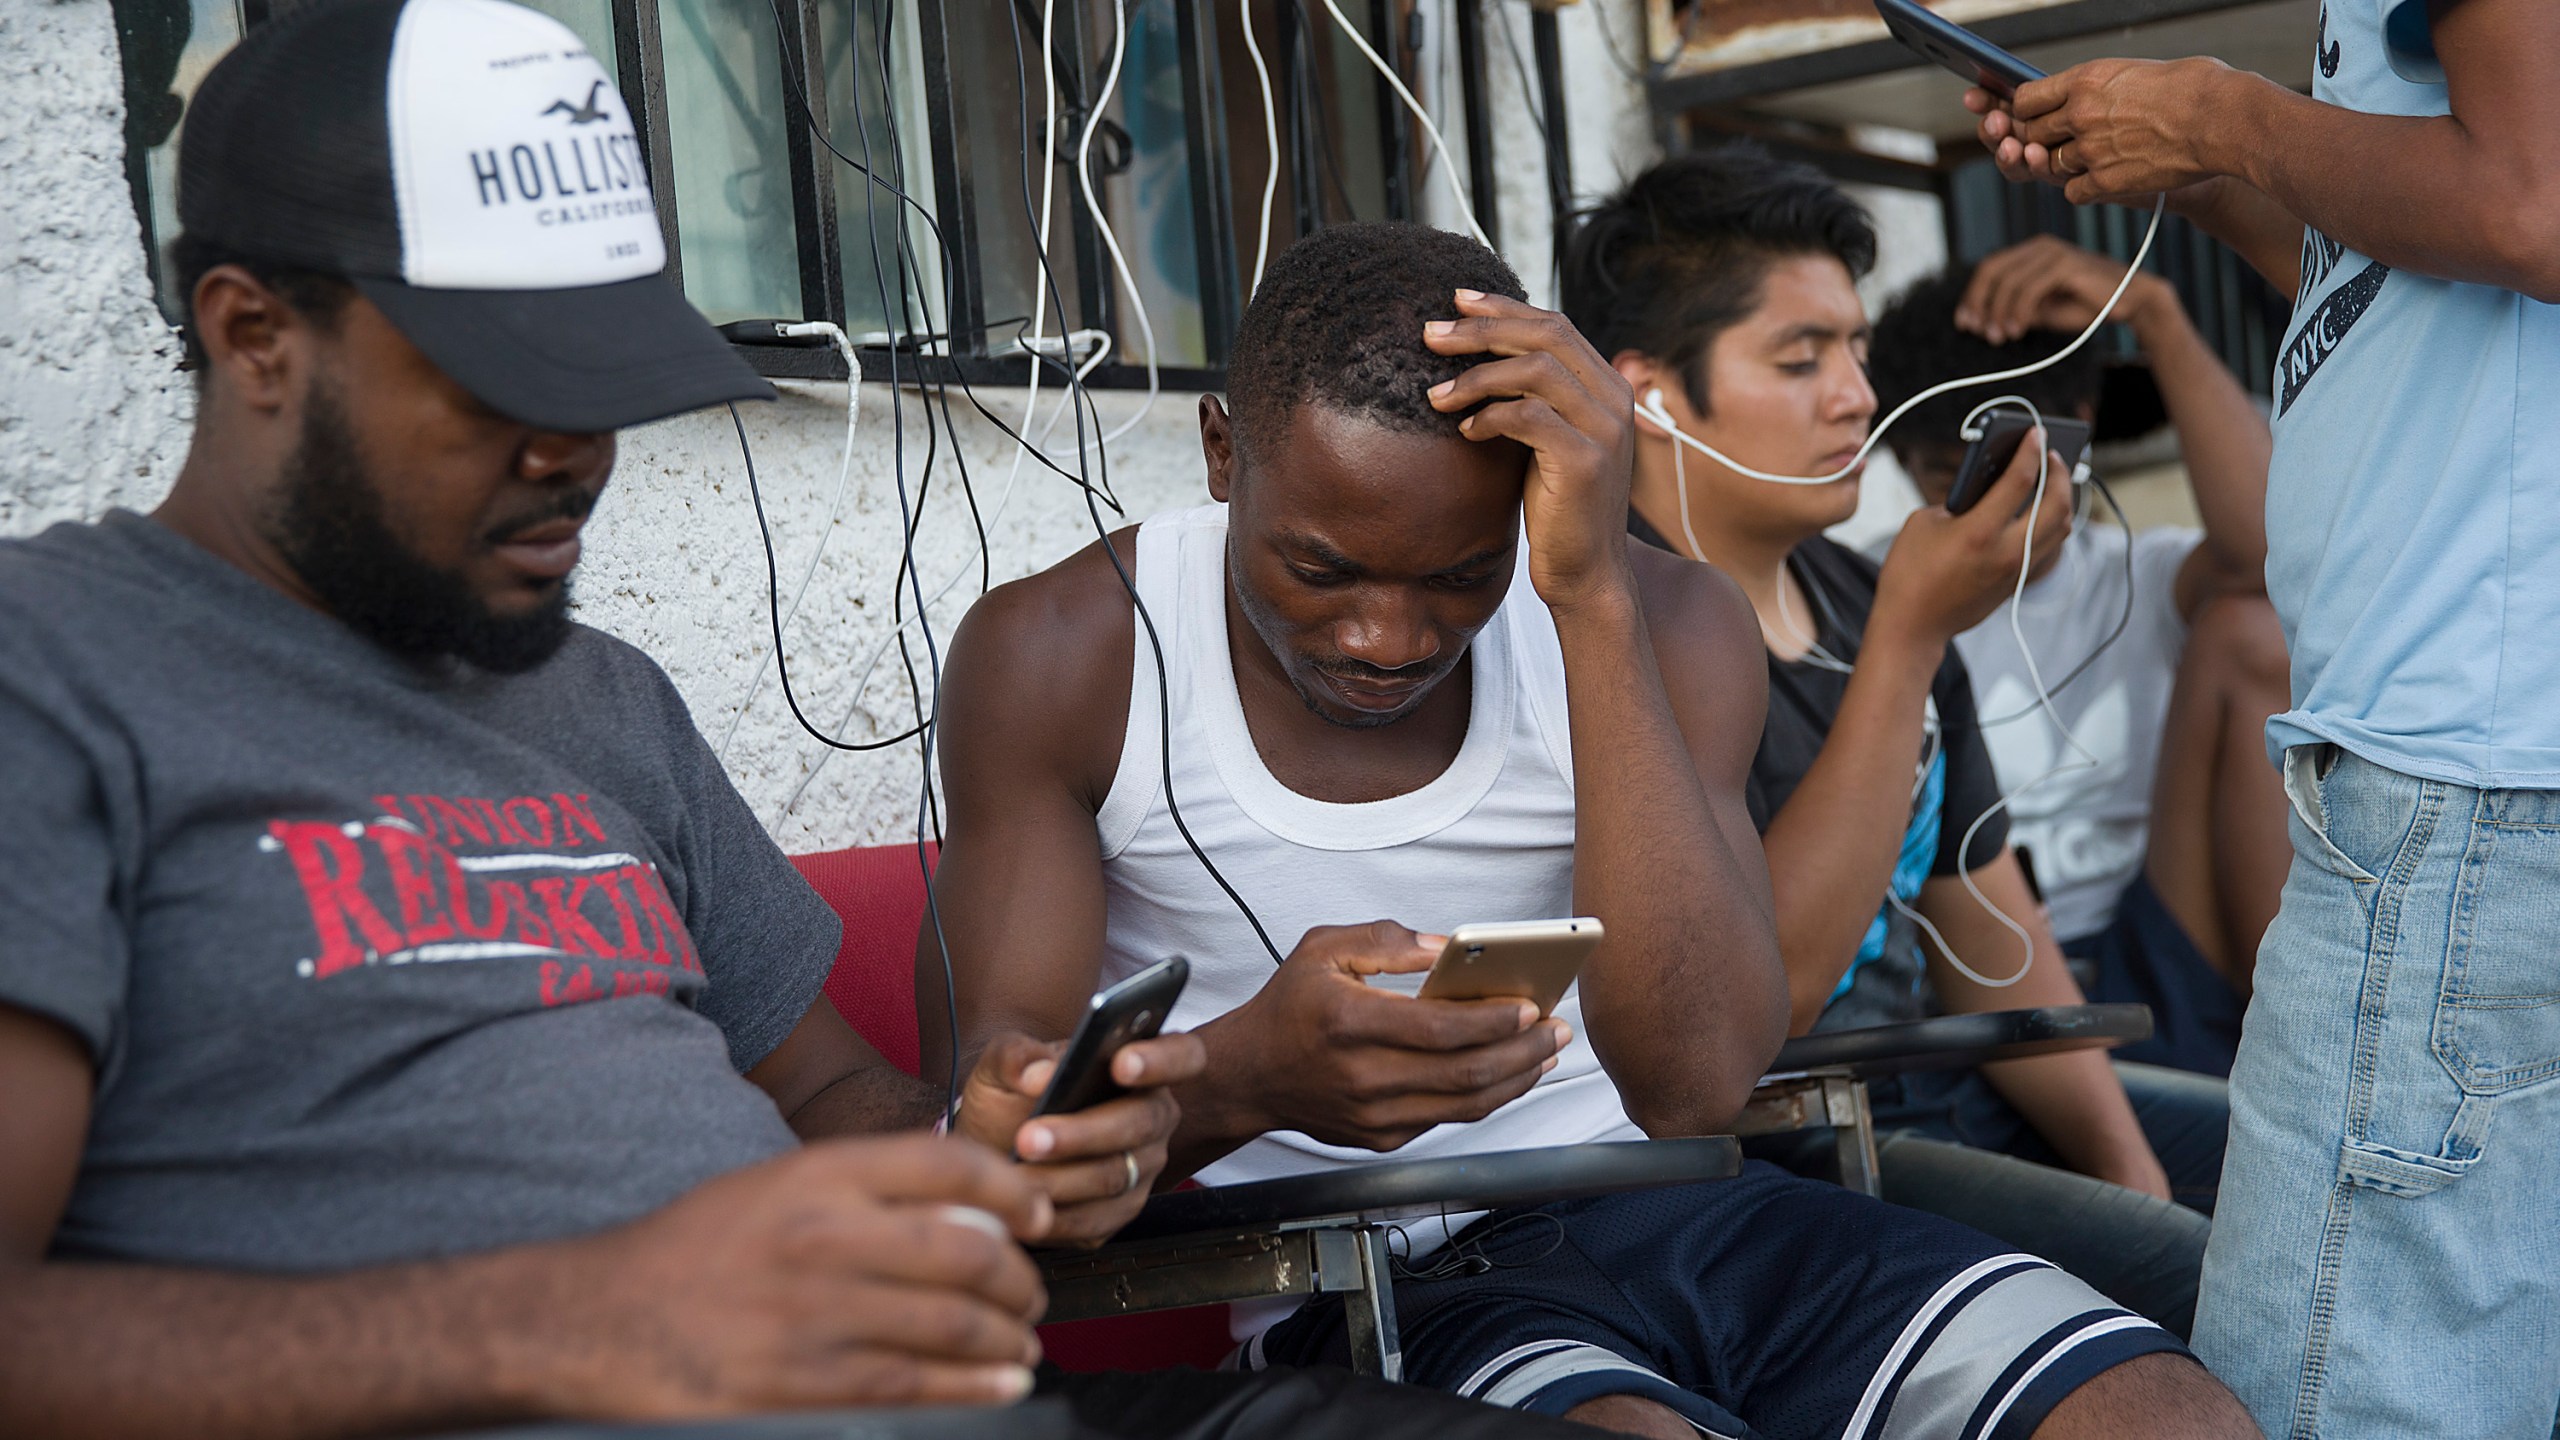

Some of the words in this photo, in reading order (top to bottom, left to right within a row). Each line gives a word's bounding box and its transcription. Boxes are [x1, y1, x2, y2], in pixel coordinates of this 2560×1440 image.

[2290, 306, 2337, 386] NYC
[373, 794, 606, 848] UNION
[268, 820, 705, 980] REDSKIN
